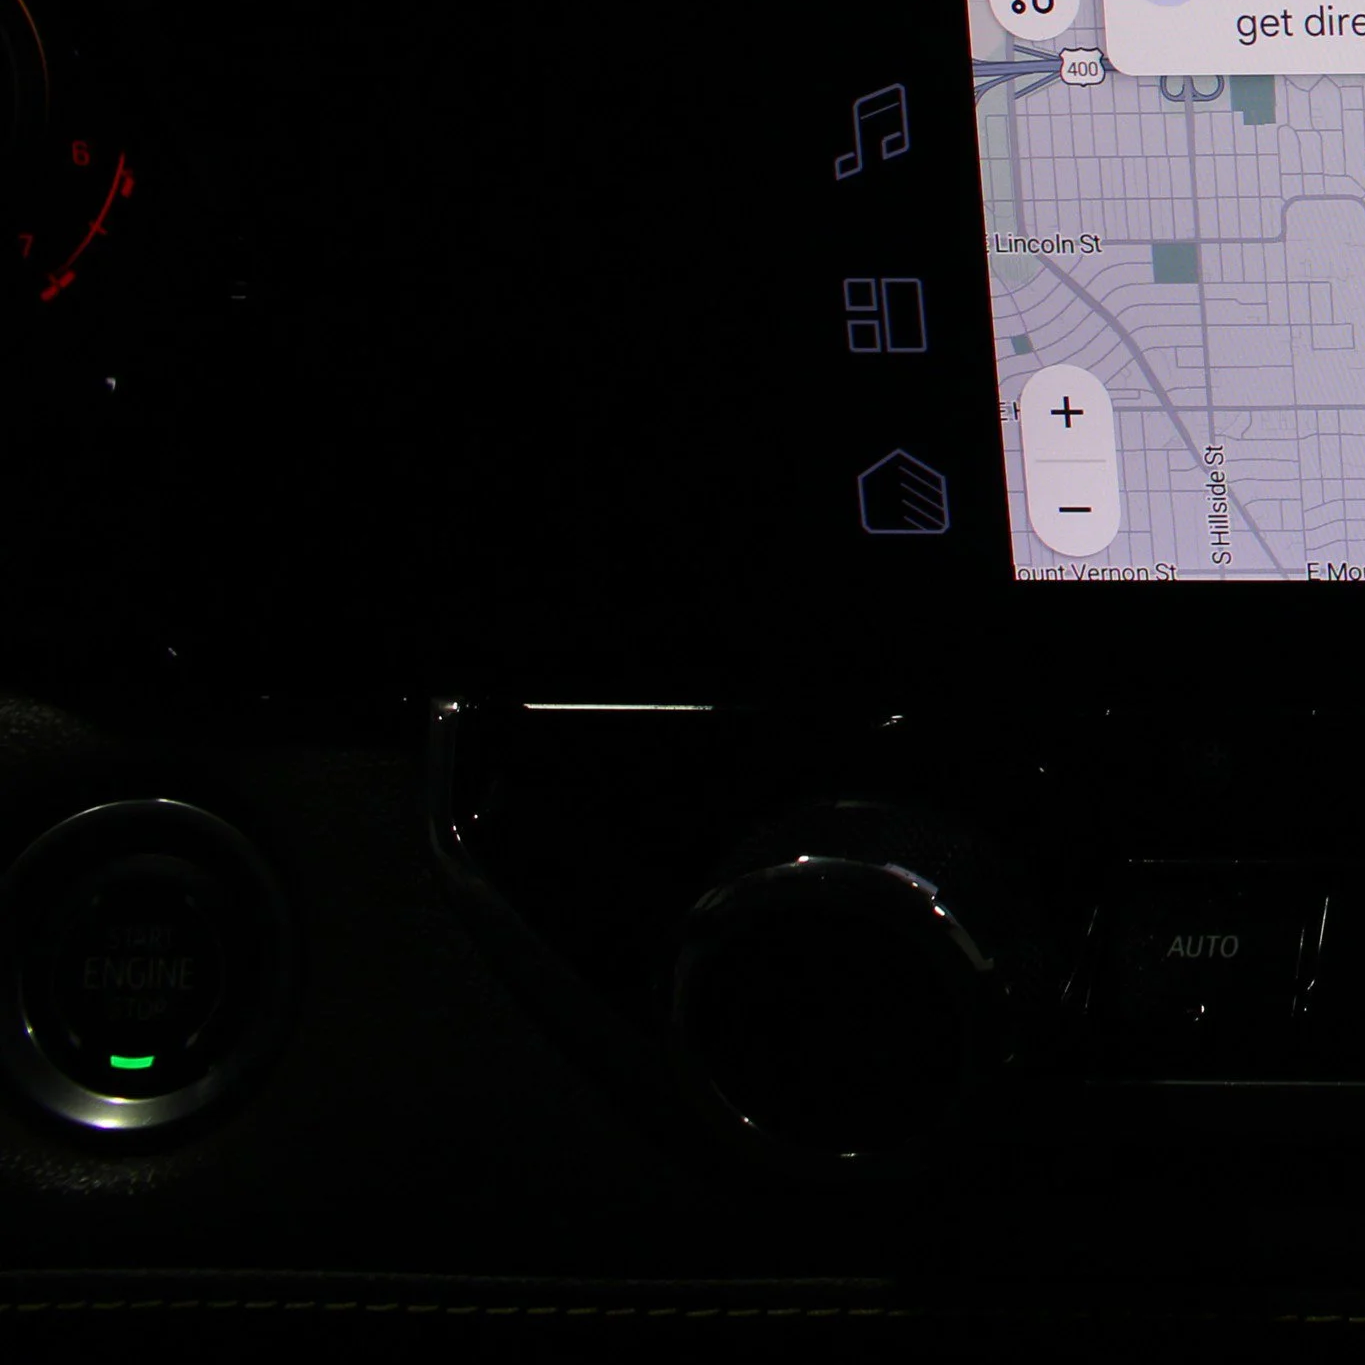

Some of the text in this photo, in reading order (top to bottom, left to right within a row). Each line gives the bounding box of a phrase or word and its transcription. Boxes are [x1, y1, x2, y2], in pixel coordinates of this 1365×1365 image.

[1236, 9, 1294, 46] get
[1068, 60, 1099, 78] 400
[995, 233, 1075, 254] Lincoln
[1079, 234, 1102, 254] St
[1204, 445, 1232, 565] S Hillside St
[1014, 563, 1178, 581] ount Vernon St
[1307, 563, 1320, 581] E
[1167, 933, 1240, 960] AUTO
